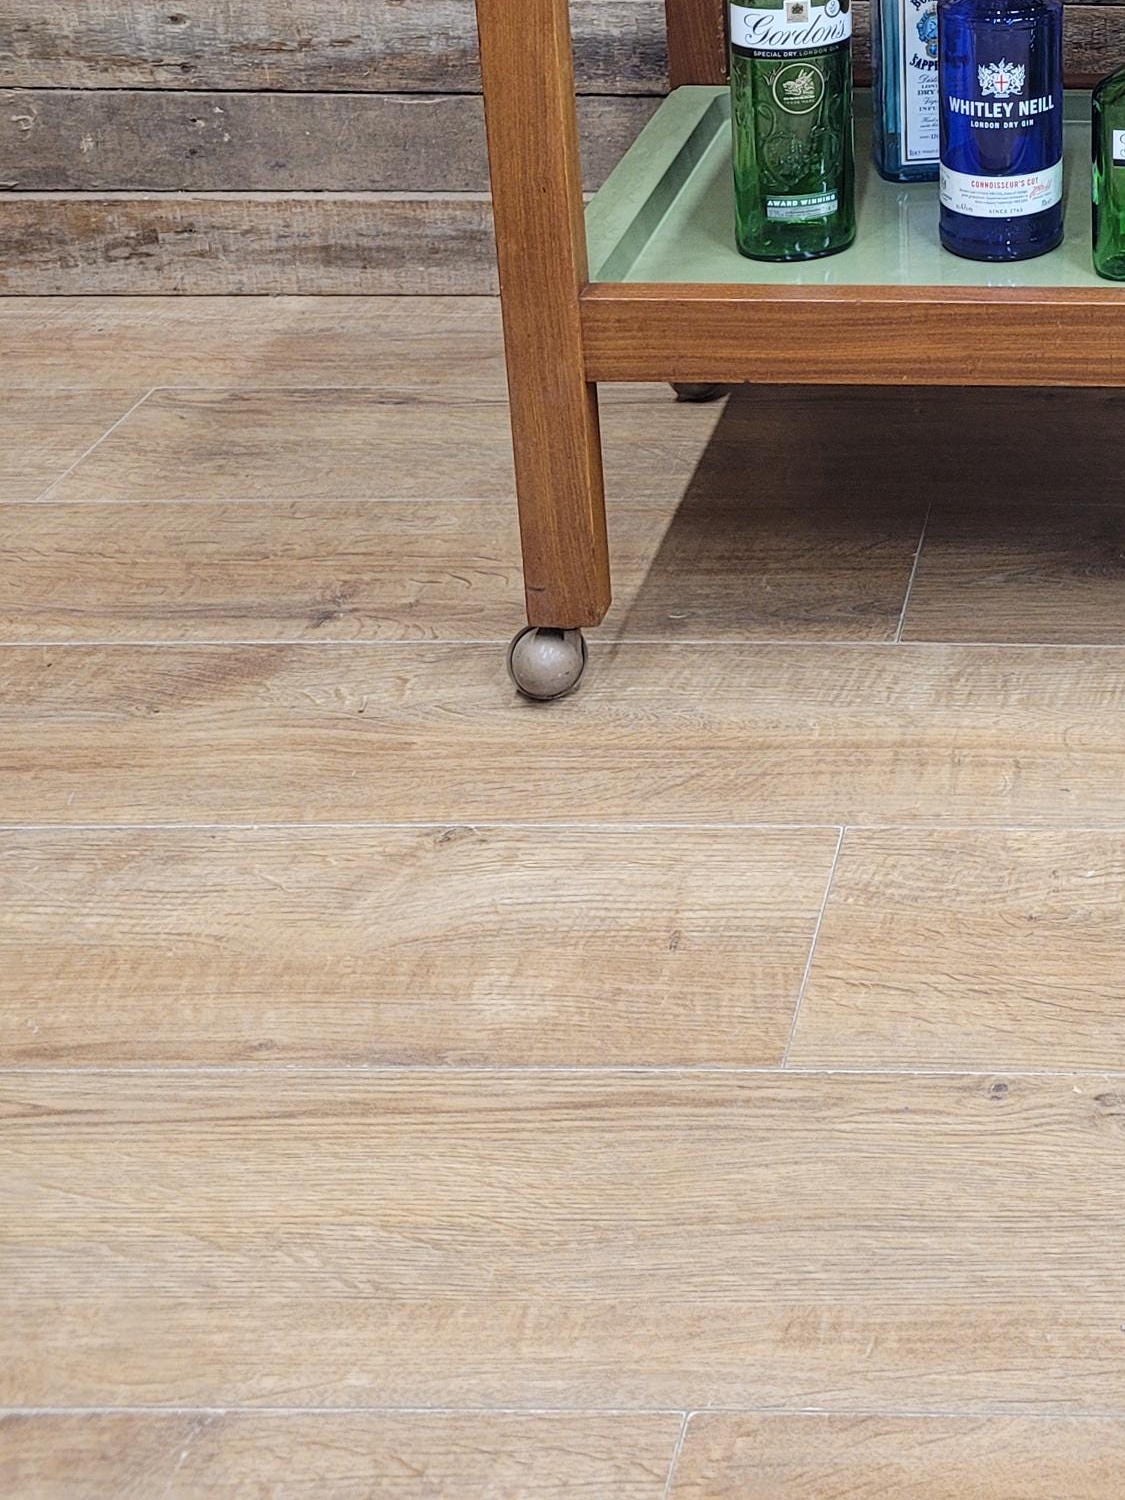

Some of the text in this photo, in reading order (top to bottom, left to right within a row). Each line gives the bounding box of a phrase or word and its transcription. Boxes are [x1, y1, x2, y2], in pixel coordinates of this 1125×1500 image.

[743, 13, 846, 46] Gordon's
[753, 50, 782, 58] SPECIAL
[799, 48, 828, 57] LONDON
[949, 94, 1055, 118] WHITLEY NEILL
[970, 120, 1000, 129] LONDON
[1021, 119, 1034, 127] GIN
[971, 180, 1025, 189] CONNOISSEUR'S
[800, 194, 836, 206] WINNING
